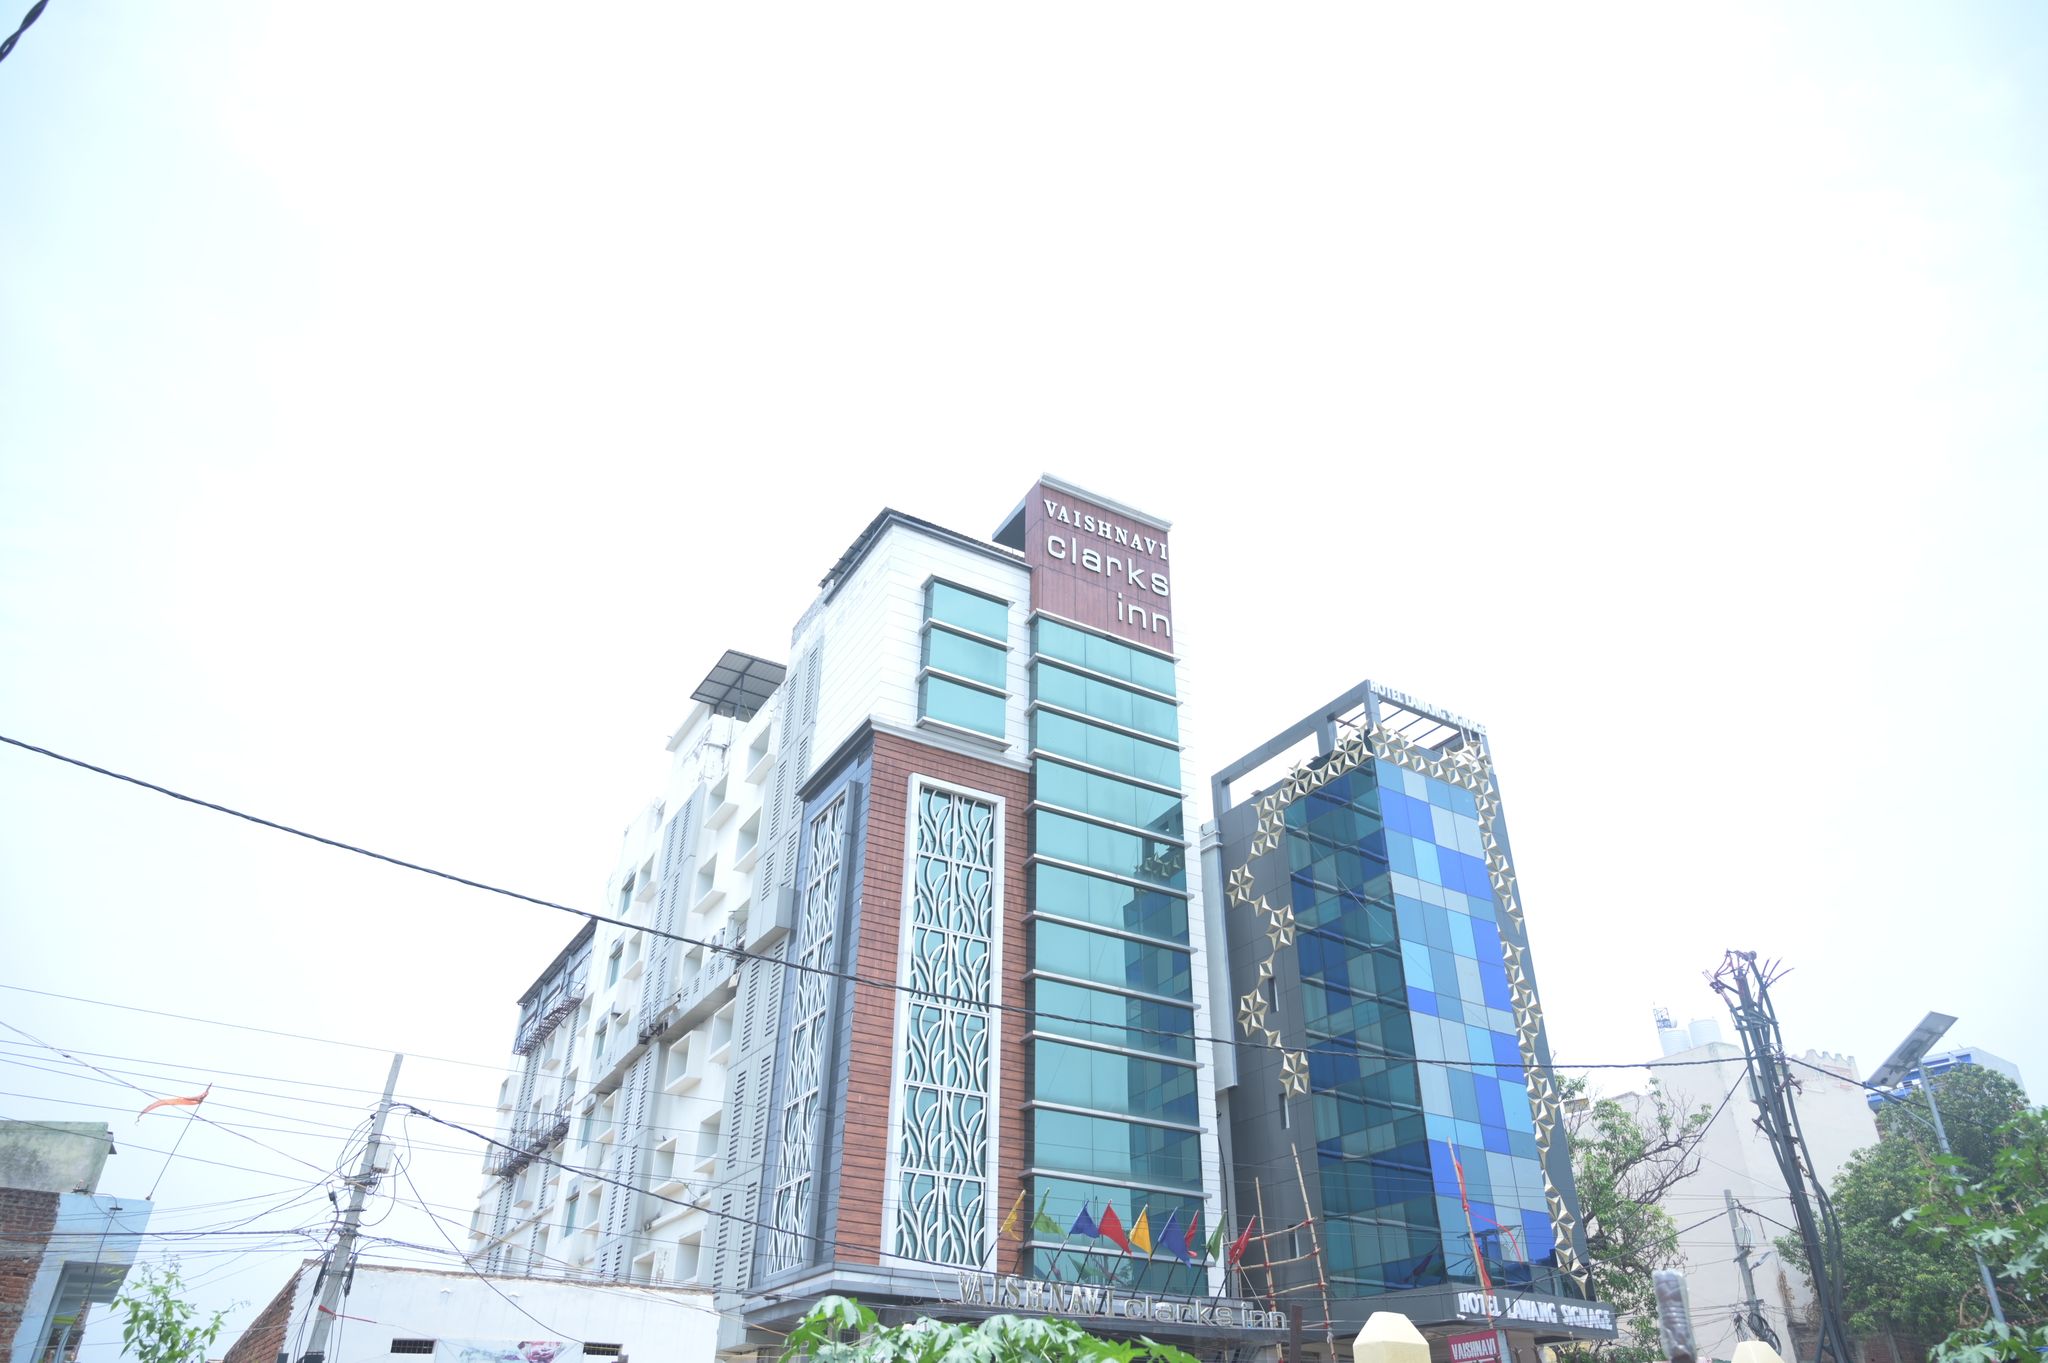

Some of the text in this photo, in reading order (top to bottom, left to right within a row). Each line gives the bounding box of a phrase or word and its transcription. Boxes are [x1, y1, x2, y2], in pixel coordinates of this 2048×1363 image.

[1044, 499, 1168, 560] VAISHNAVI
[1047, 535, 1169, 597] clarks
[1117, 592, 1171, 637] inn
[958, 1271, 1287, 1330] VAISHNAVI clarks inn
[1458, 1292, 1502, 1317] HOTEL
[1451, 1338, 1497, 1360] VAISHNAVI
